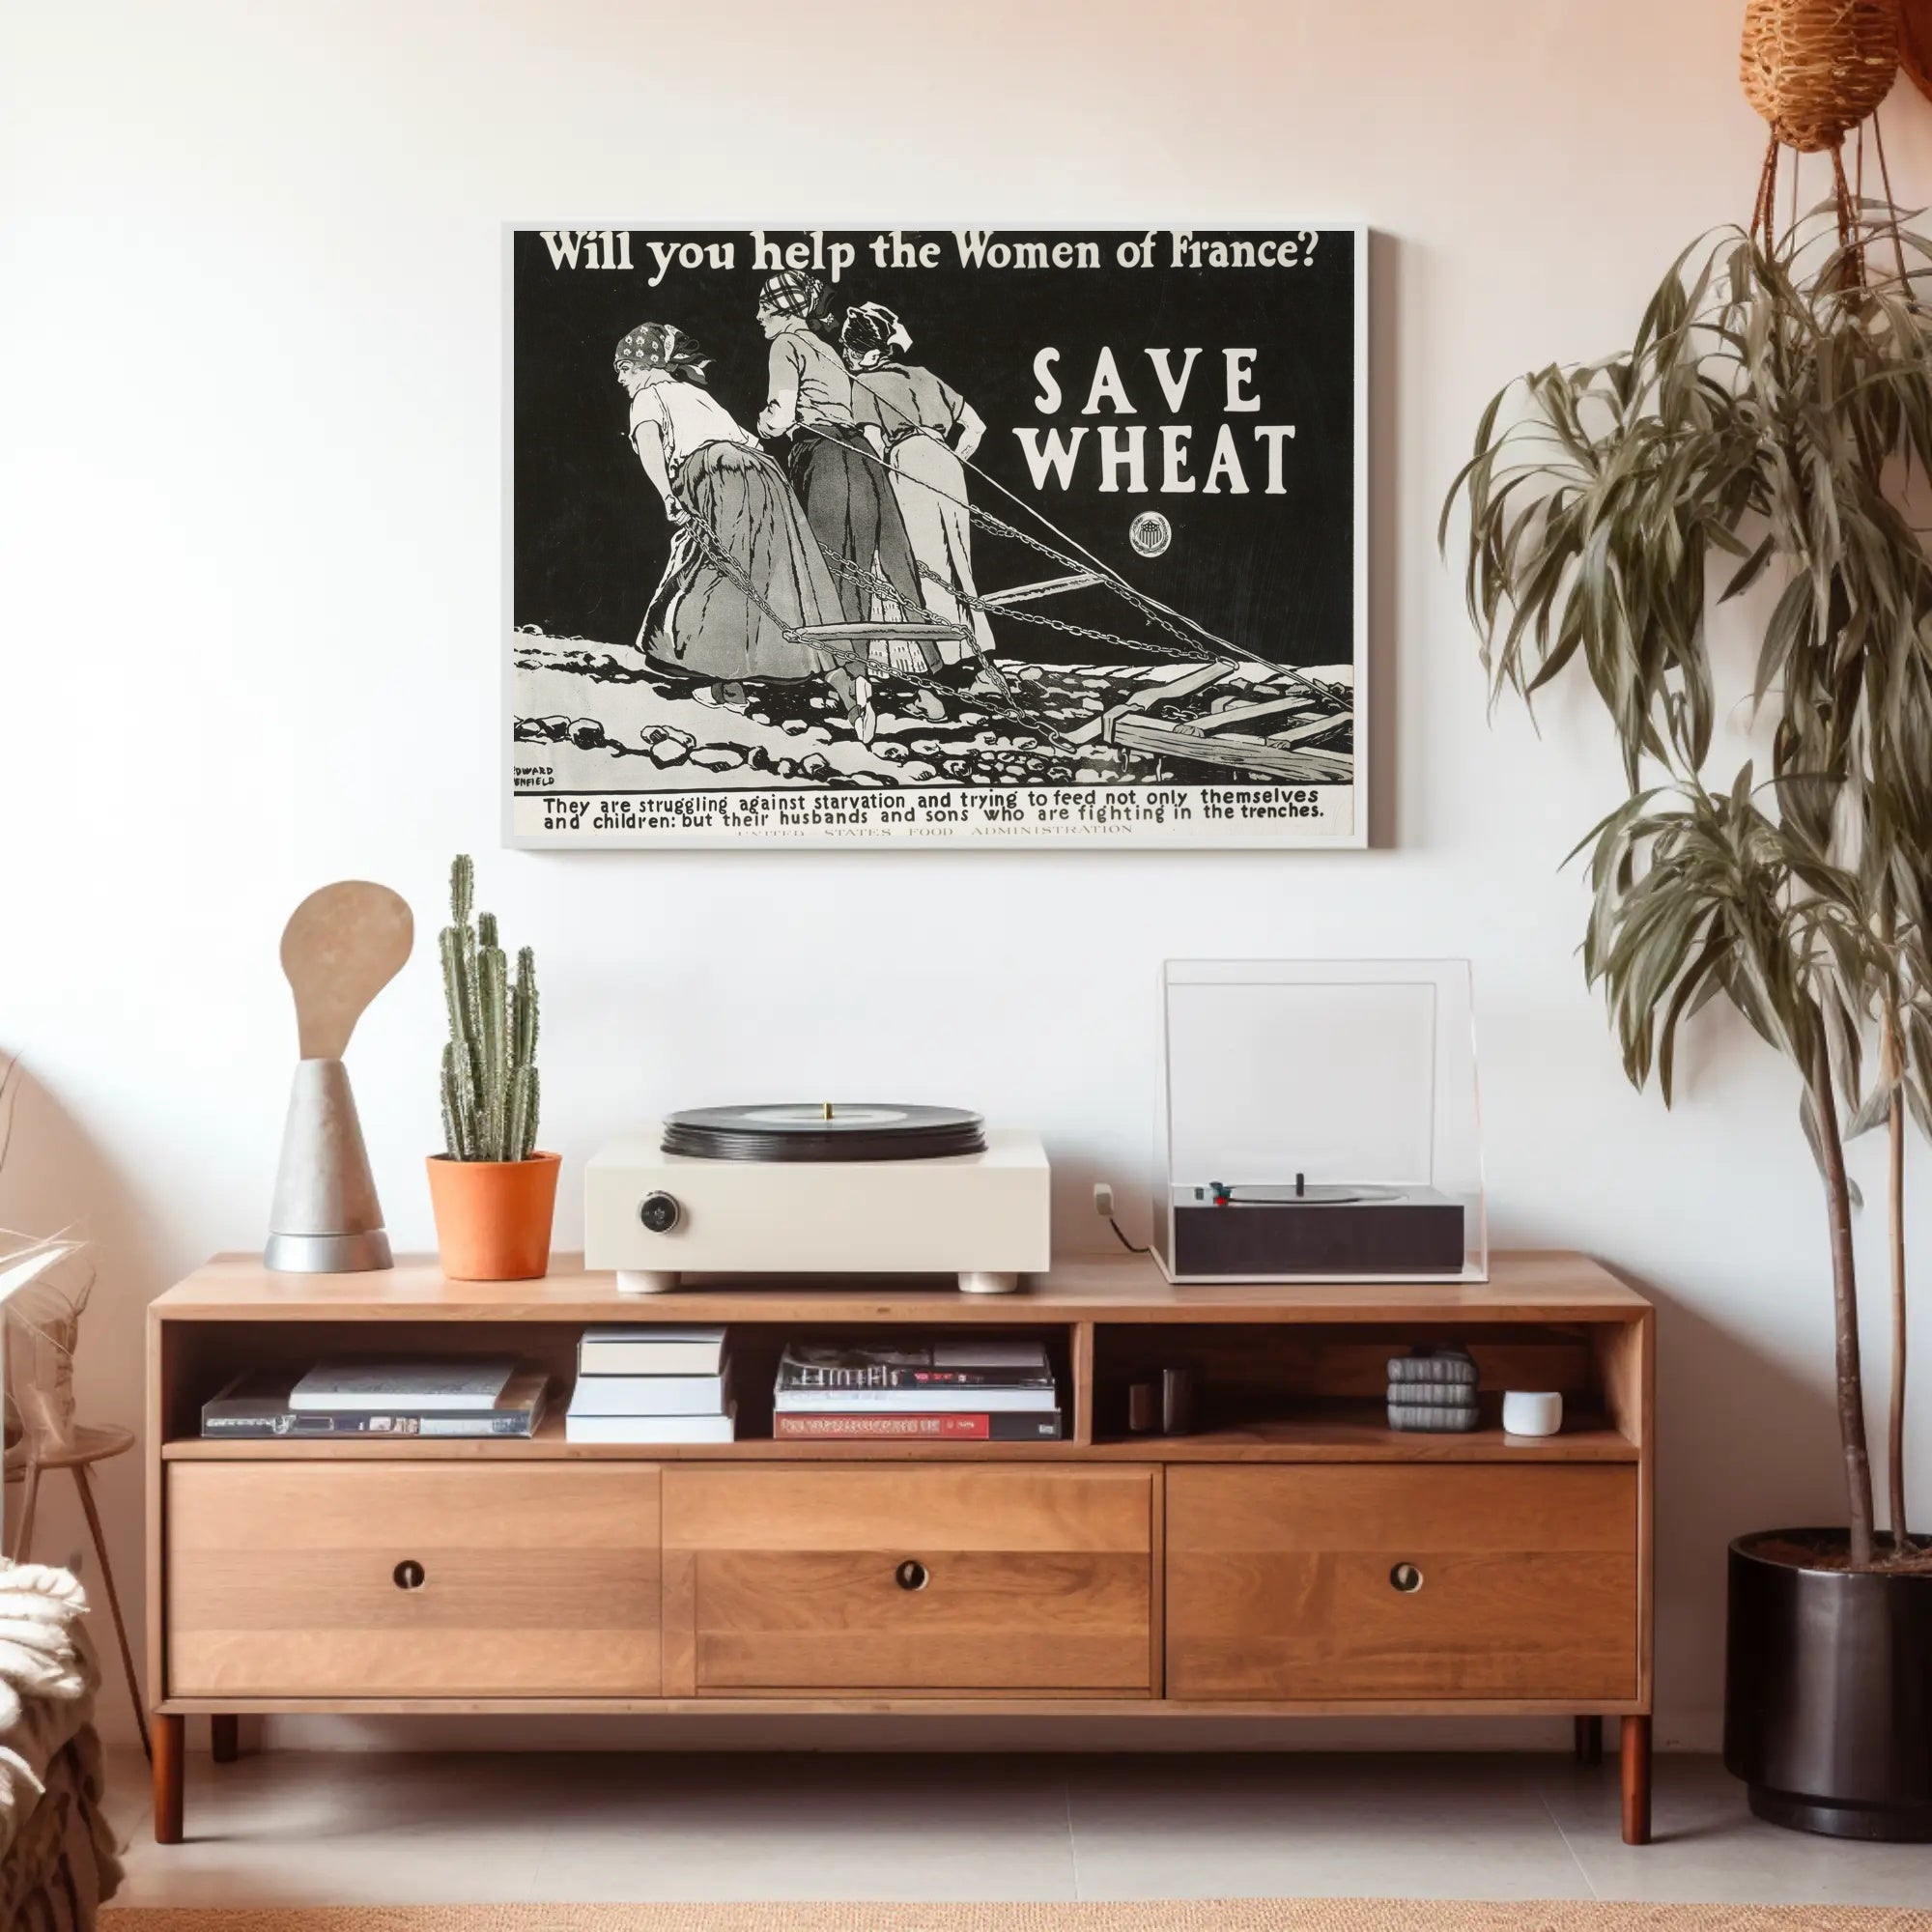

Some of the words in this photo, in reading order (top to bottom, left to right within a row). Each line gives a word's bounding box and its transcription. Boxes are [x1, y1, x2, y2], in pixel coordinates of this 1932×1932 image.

[539, 231, 635, 270] Will
[645, 242, 735, 288] you
[749, 231, 856, 283] help
[868, 231, 941, 270] the
[951, 231, 1101, 269] Women
[1116, 231, 1159, 269] of
[1170, 231, 1320, 268] France?
[1033, 346, 1261, 414] SAVE
[1011, 423, 1296, 495] WHEAT
[513, 765, 554, 776] DWARD
[513, 777, 554, 786] ENFIELD
[543, 798, 590, 816] They
[600, 801, 631, 813] are
[639, 796, 728, 815] struggling
[739, 794, 806, 815] against
[814, 793, 905, 810] starvation
[918, 791, 952, 809] and
[960, 789, 1018, 810] trying
[1027, 791, 1048, 807] to
[1053, 789, 1096, 806] feed
[1105, 789, 1136, 806] not
[1146, 789, 1188, 808] only
[1200, 787, 1319, 805] themselves
[544, 814, 580, 830] and
[593, 812, 675, 830] children:
[682, 812, 713, 828] but
[723, 811, 769, 827] their
[780, 809, 867, 825] husbands
[880, 807, 916, 823] and
[925, 810, 969, 822] sons
[983, 807, 1025, 821] who
[1037, 809, 1069, 821] are
[1078, 805, 1165, 824] fighting
[1174, 804, 1192, 820] in
[1203, 804, 1235, 819] the
[1240, 802, 1324, 818] trenches.
[824, 828, 892, 837] STATES
[908, 828, 953, 837] FOOD
[971, 825, 1133, 836] ADMINISTRATION
